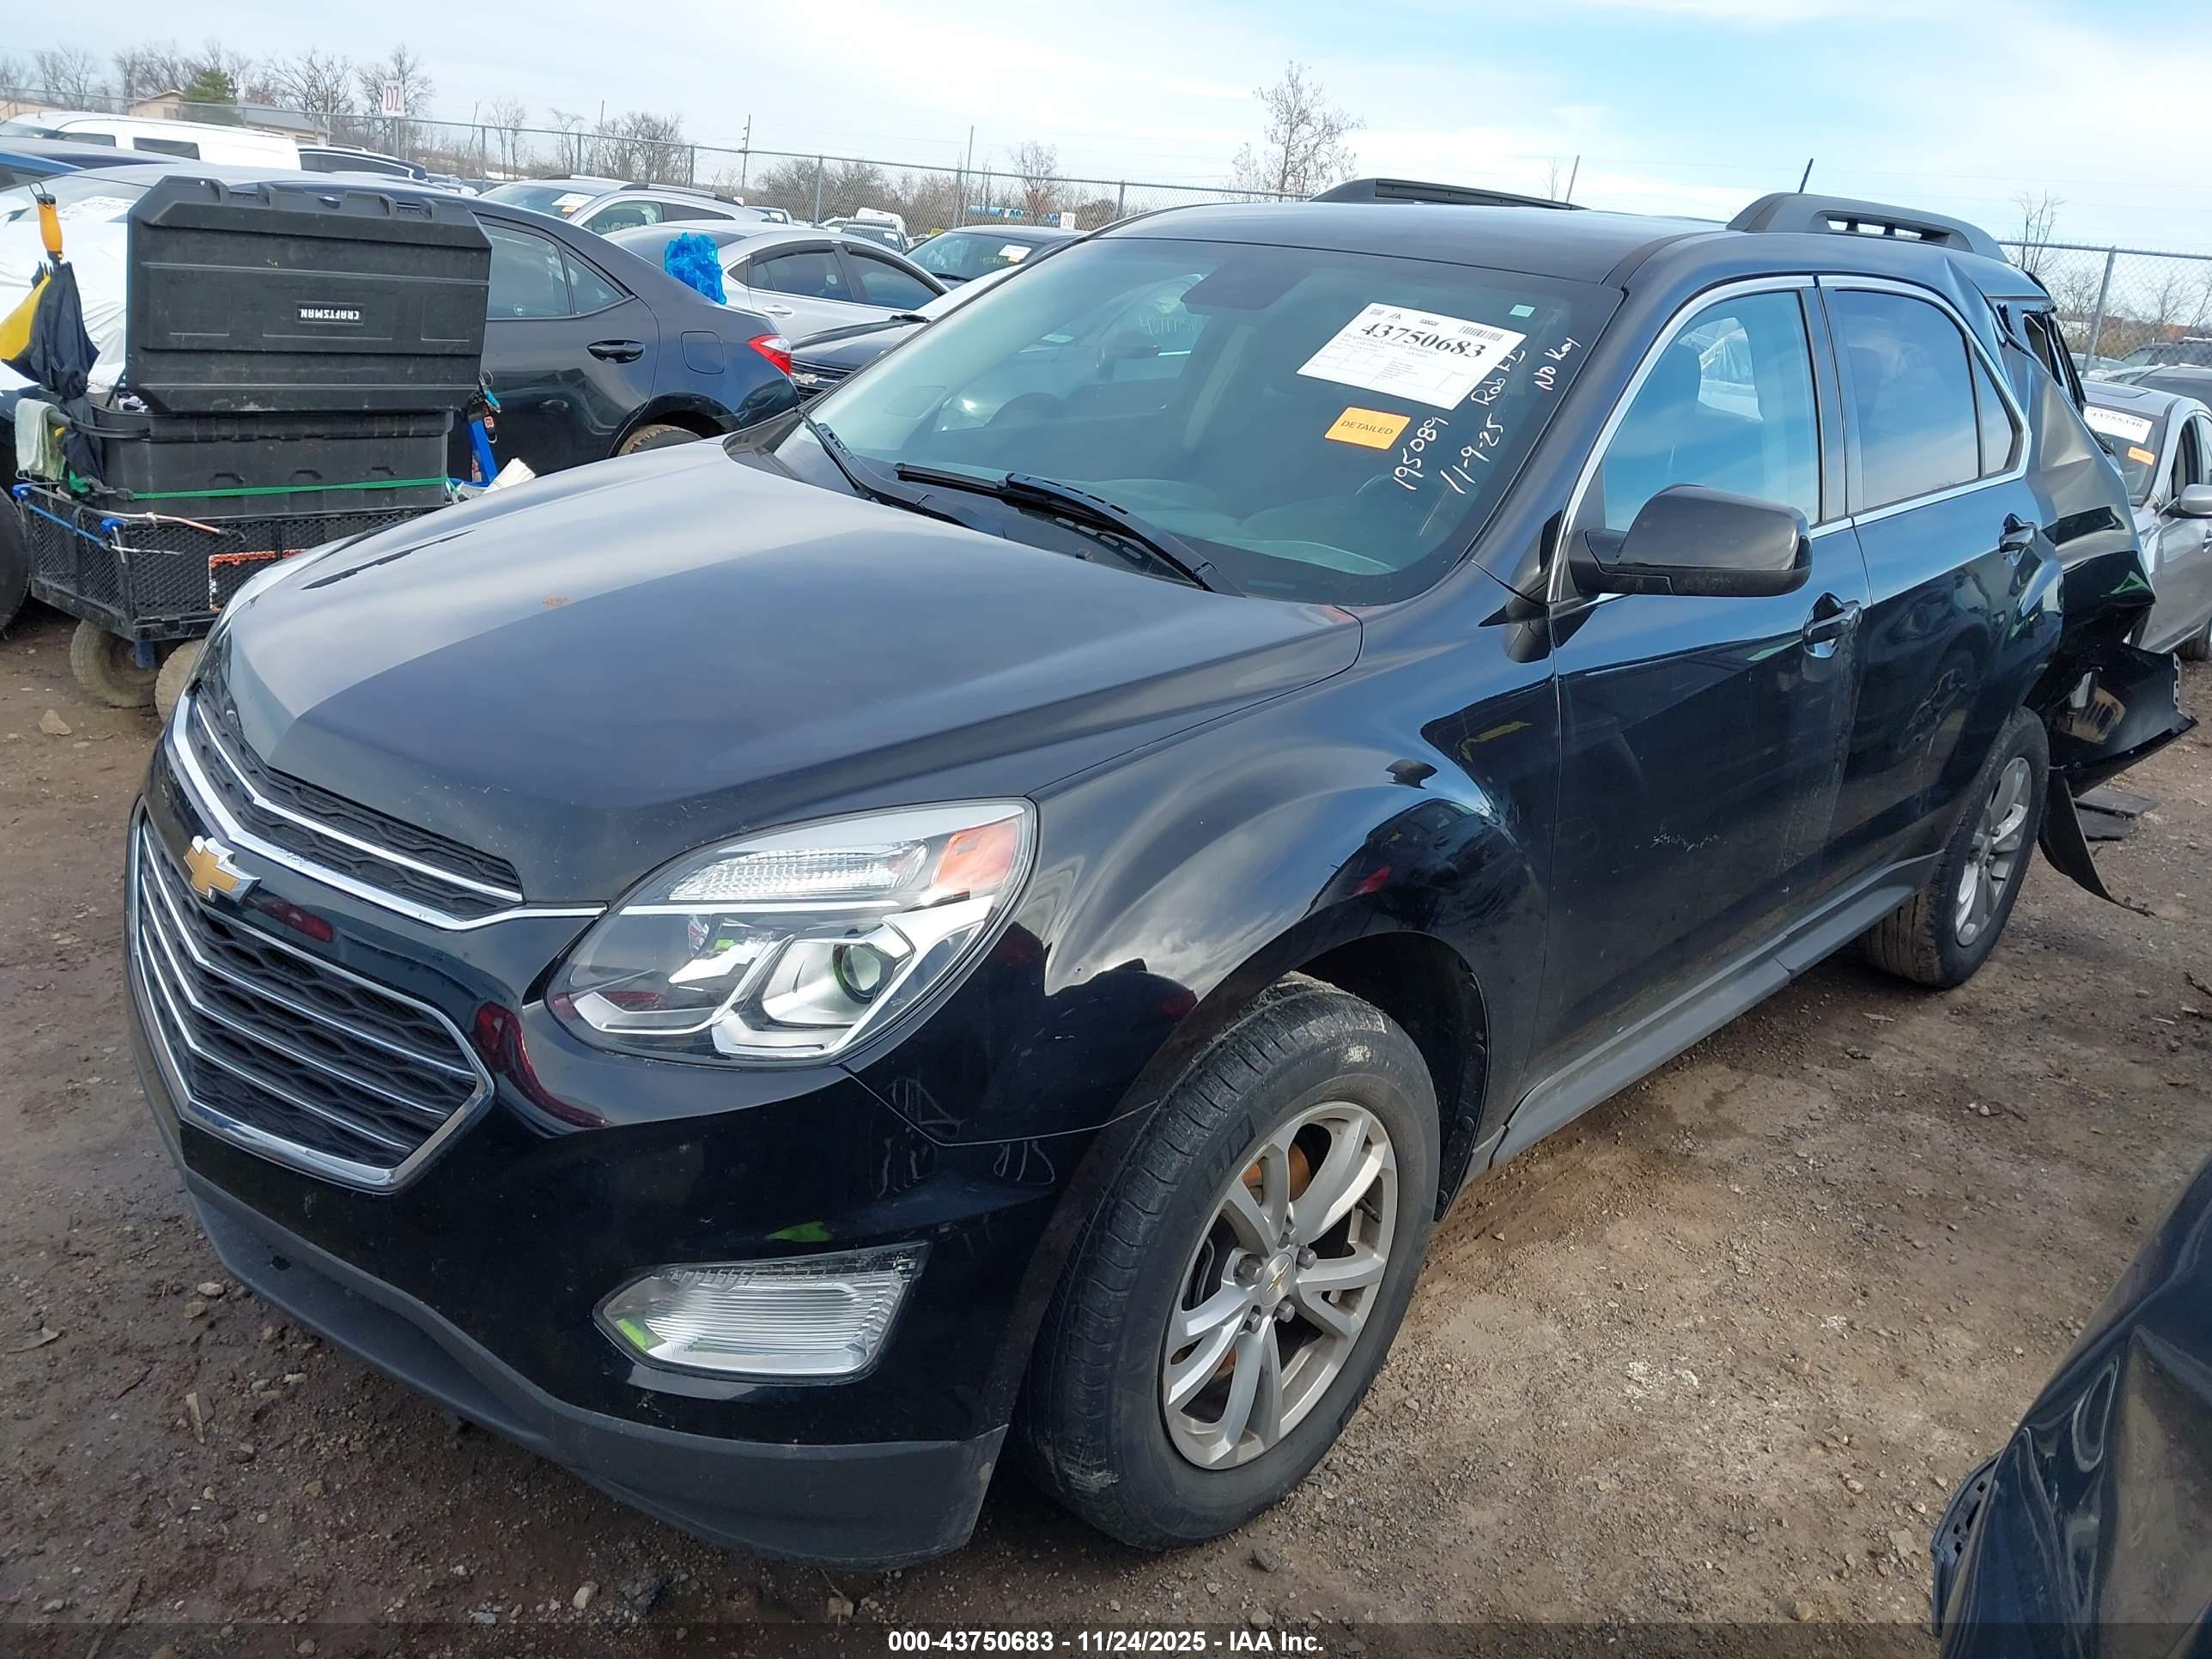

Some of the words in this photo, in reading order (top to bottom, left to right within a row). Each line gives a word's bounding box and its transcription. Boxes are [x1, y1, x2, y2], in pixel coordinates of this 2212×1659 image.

[299, 308, 360, 320] CRAFTSMAN
[1360, 323, 1487, 358] 43750683
[1340, 420, 1394, 434] DETAILED
[1439, 412, 1504, 495] 11-9-25
